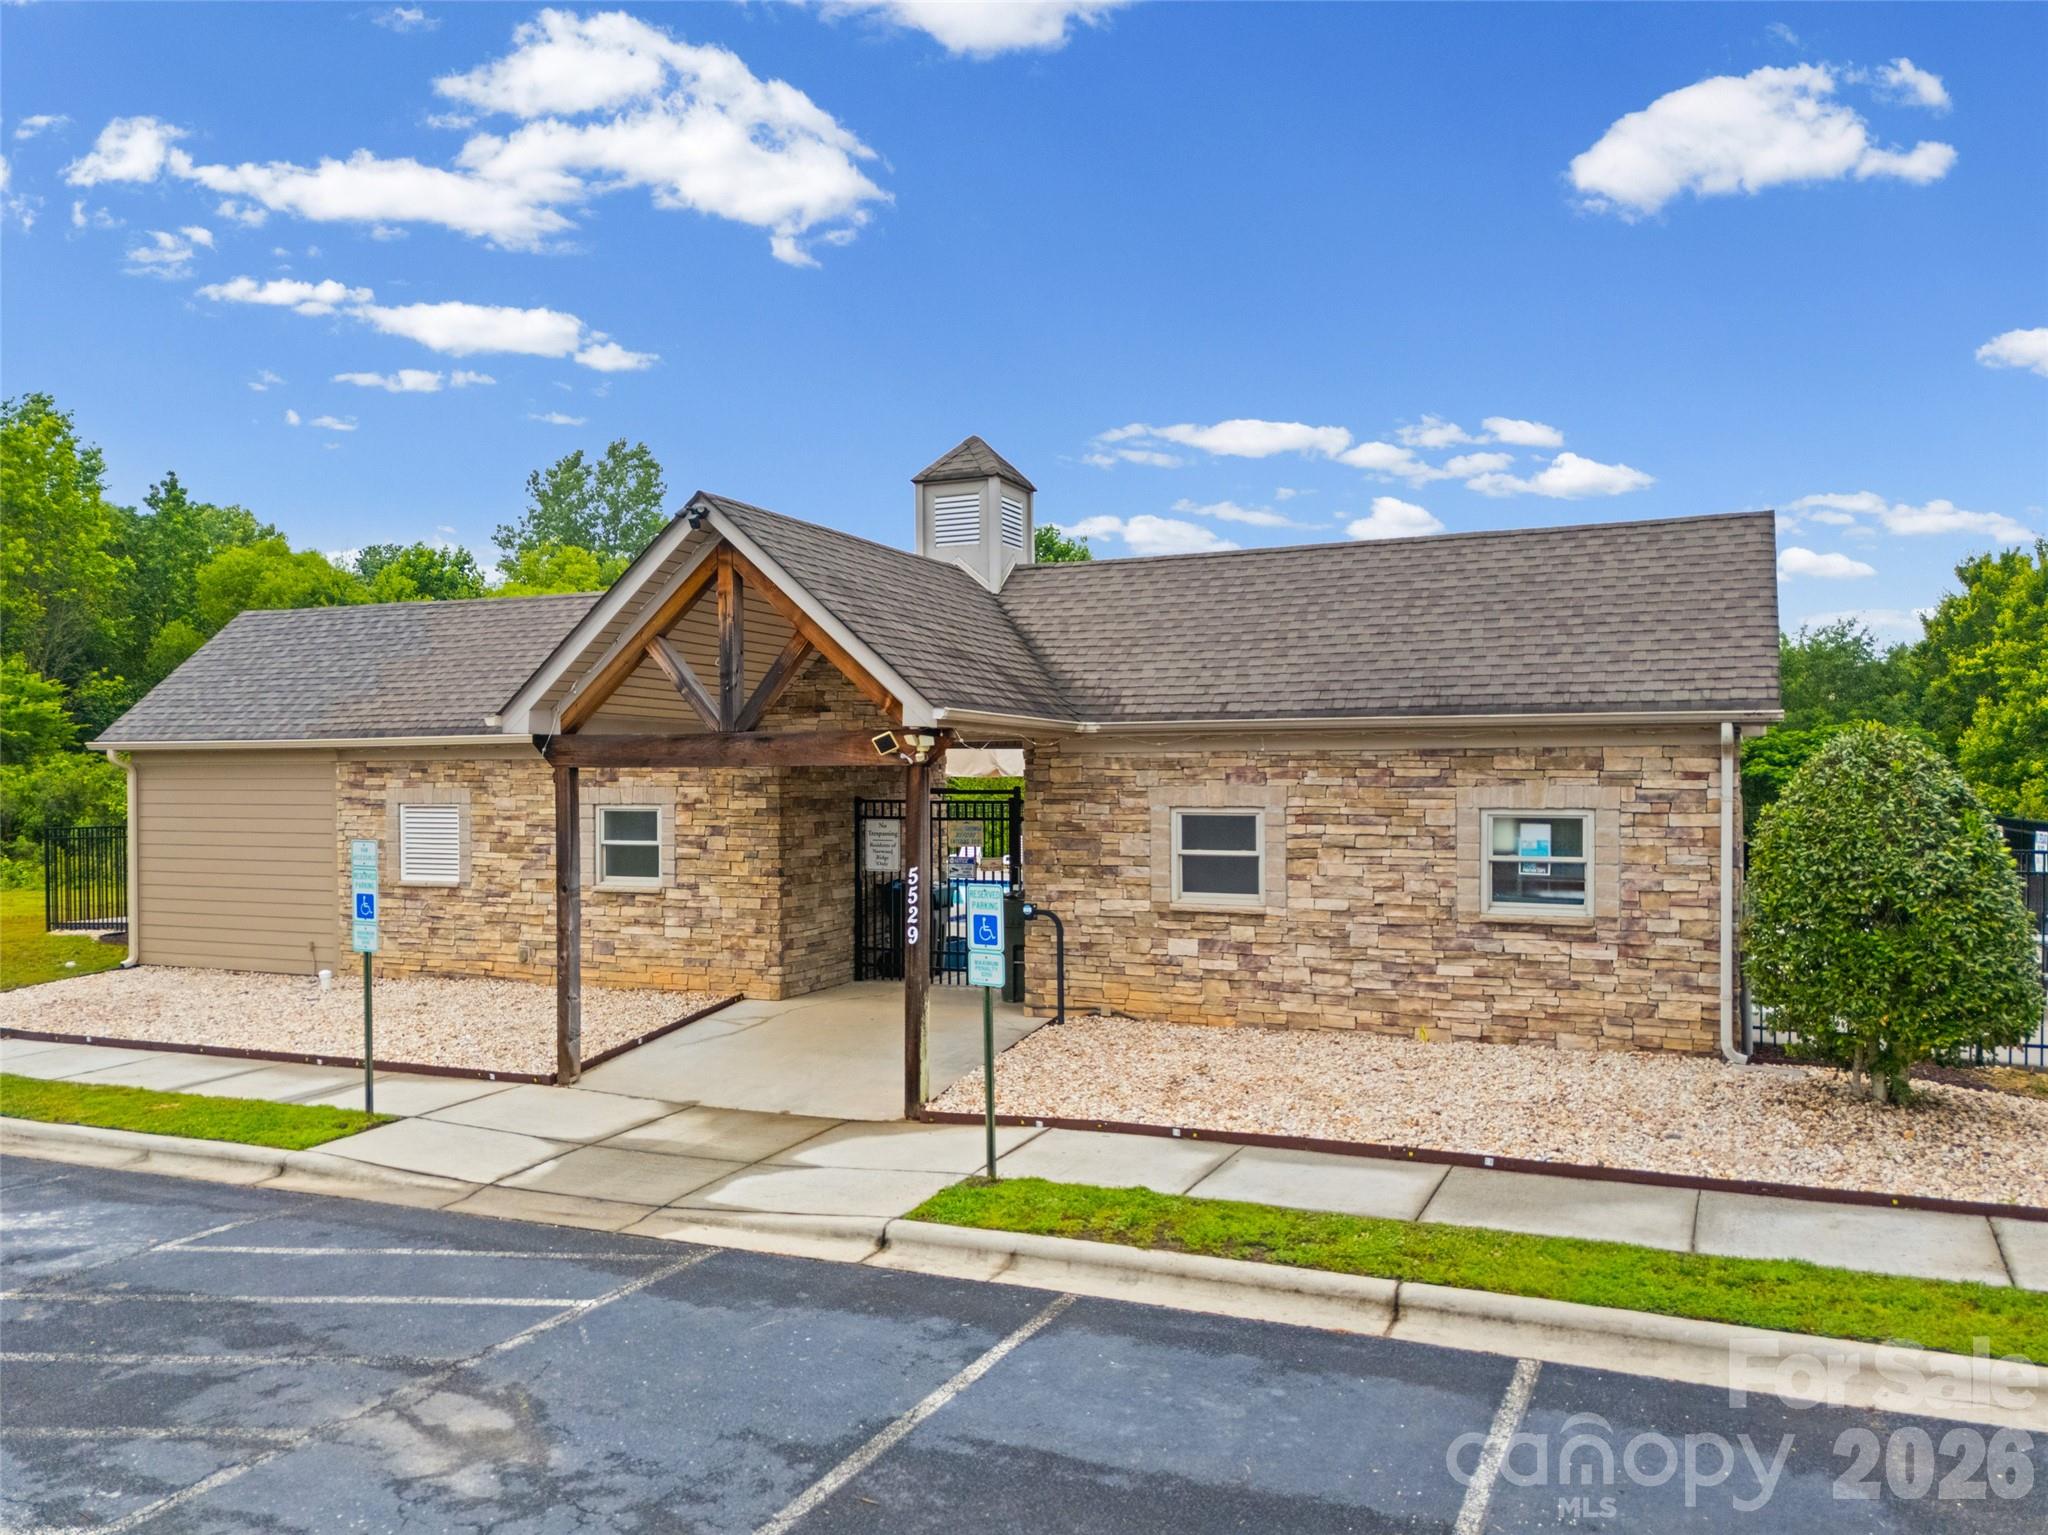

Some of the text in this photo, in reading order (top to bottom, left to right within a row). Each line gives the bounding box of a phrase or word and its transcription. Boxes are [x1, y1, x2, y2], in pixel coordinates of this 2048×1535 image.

[969, 890, 1001, 898] RESERVED
[907, 866, 919, 945] 5529
[972, 901, 998, 909] PARKING
